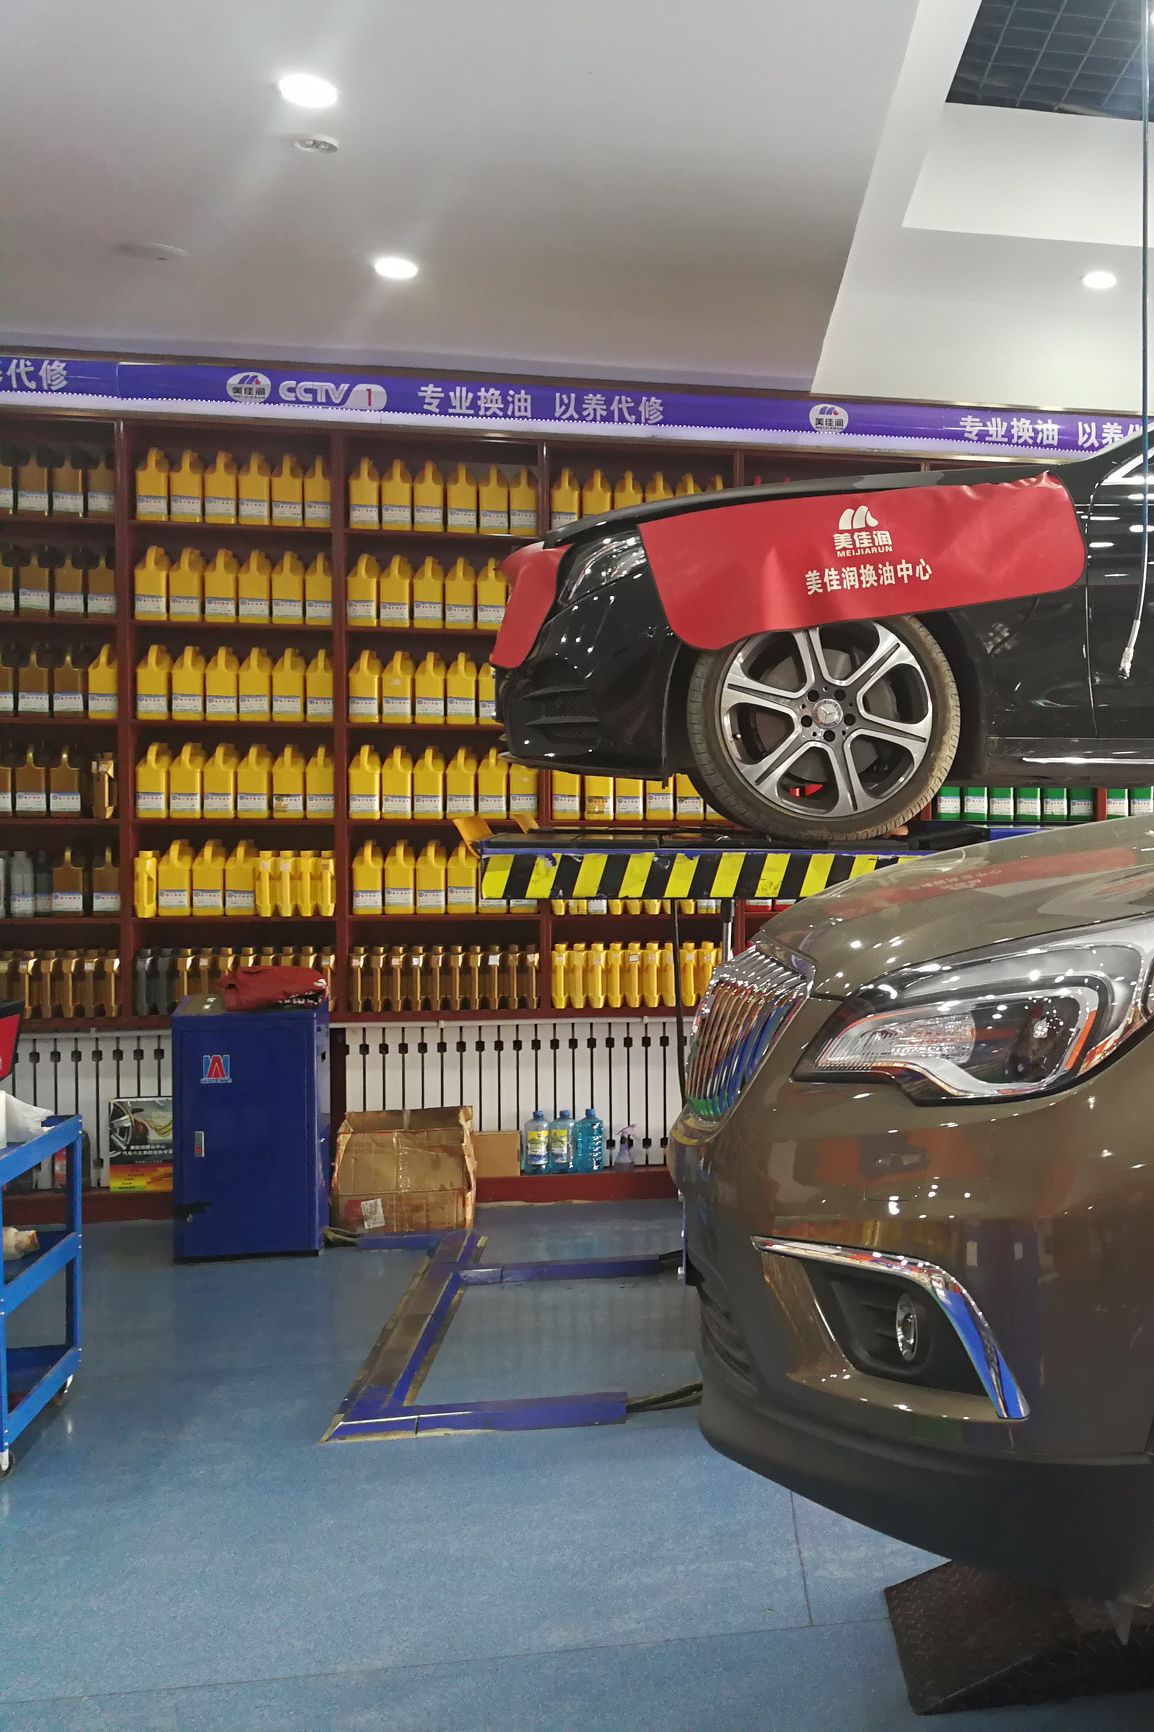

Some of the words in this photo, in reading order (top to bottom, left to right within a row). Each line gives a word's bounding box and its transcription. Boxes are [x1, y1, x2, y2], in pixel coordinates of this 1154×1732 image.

[0, 359, 68, 391] 代修
[279, 381, 349, 404] CCTV
[418, 384, 532, 418] 专业换油
[554, 392, 664, 424] 以养代修
[960, 415, 1060, 446] 专业换油
[833, 530, 893, 550] 美佳润
[837, 545, 893, 558] MEIJIARUN
[805, 558, 932, 595] 美佳润换油中心
